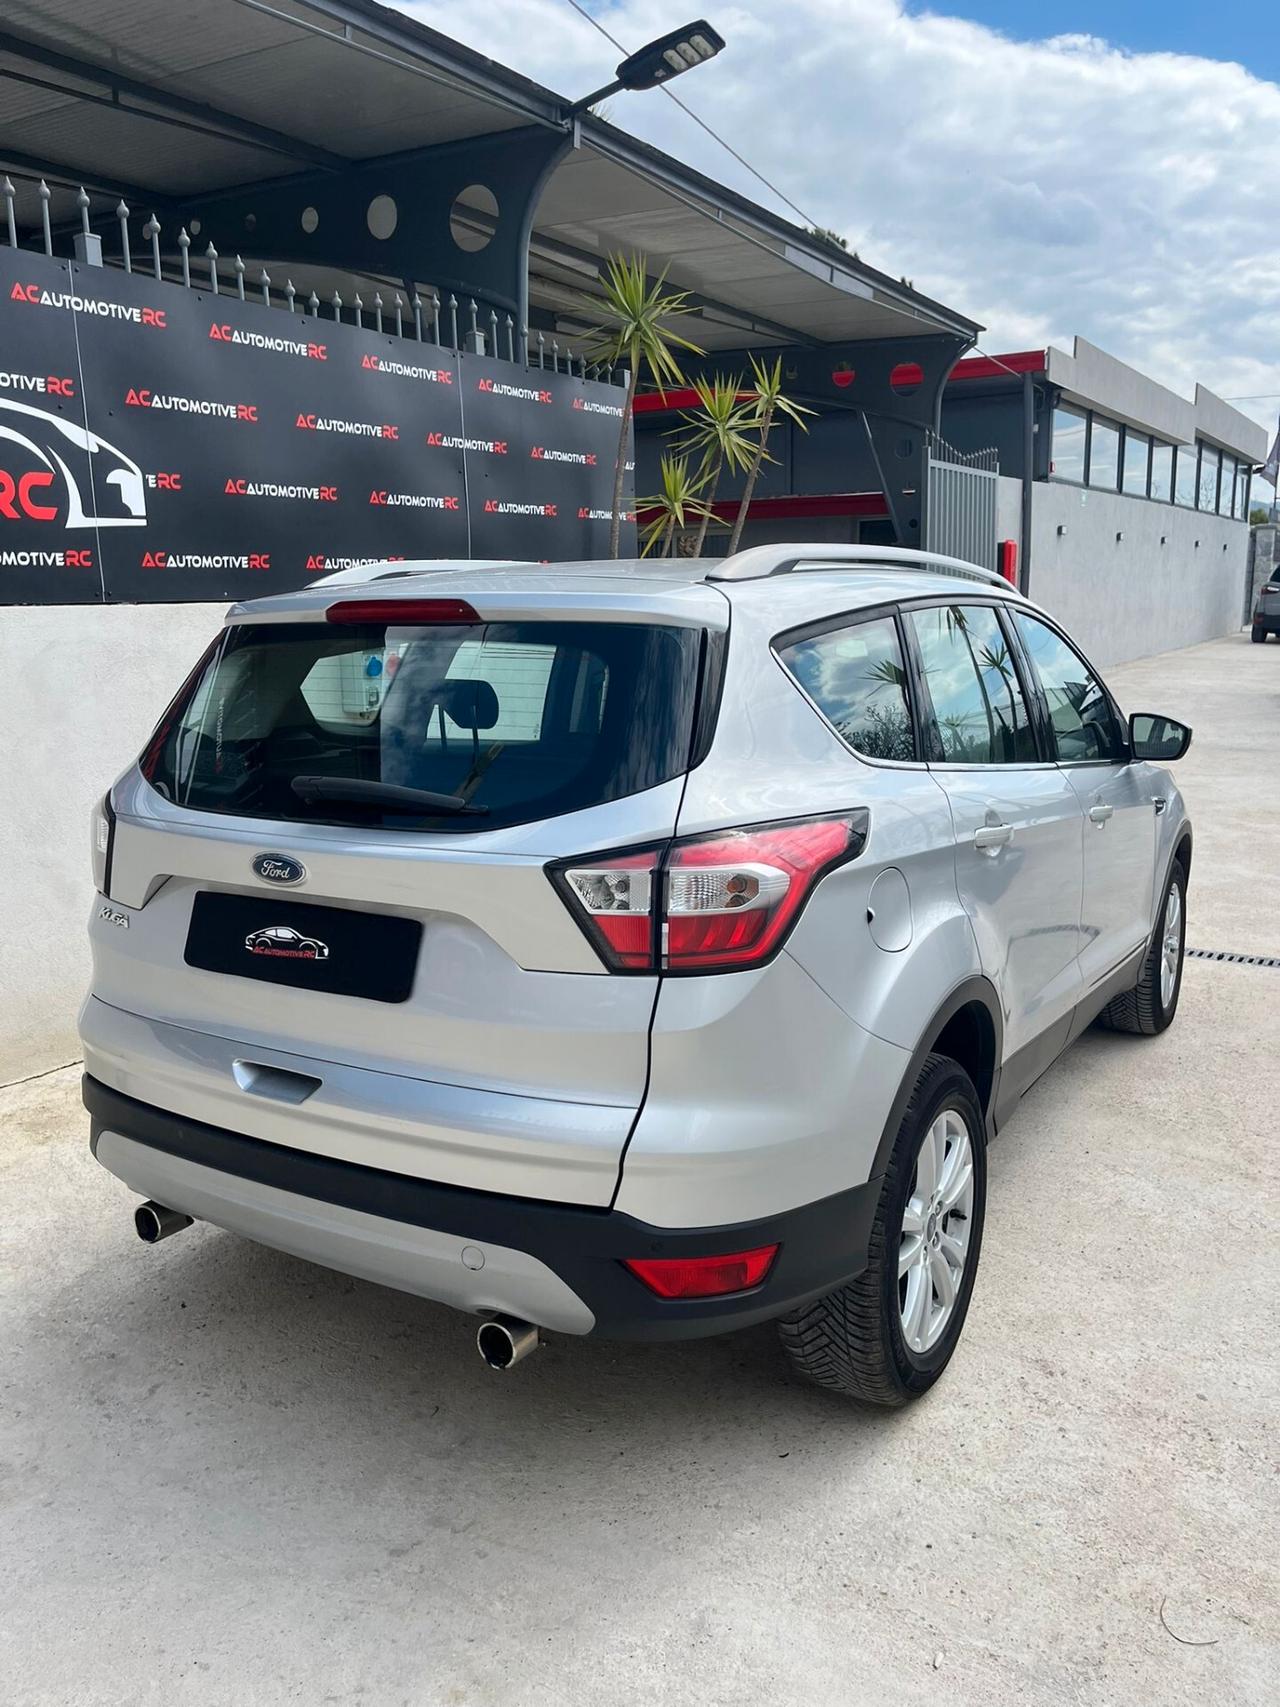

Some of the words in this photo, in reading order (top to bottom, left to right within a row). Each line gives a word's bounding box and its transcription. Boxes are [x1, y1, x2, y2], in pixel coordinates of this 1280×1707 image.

[10, 282, 167, 328] ACAUTOMOTIVERC
[209, 323, 328, 360] ACAUTOMOTIVERC
[361, 354, 453, 385] ACAUTOMOTIVERC
[478, 378, 553, 404] ACAUTOMOTIVERC
[125, 389, 258, 422] ACAUTOMOTIVERC
[573, 398, 633, 419] ACAUTOMOTIVE
[296, 413, 399, 441] ACAUTOMOTIVERC
[427, 432, 508, 455] ACAUTOMOTIVERC
[531, 446, 597, 466] ACAUTOMOTIVERC
[146, 472, 182, 490] ERC
[224, 478, 337, 501] ACAUTOMOTIVERC
[369, 490, 460, 511] ACAUTOMOTIVERC
[484, 500, 558, 517] ACAUTOMOTIVERC
[0, 550, 93, 567] MOTIVERC
[141, 552, 270, 569] ACAUTOMOTIVERC
[261, 859, 290, 878] Ford
